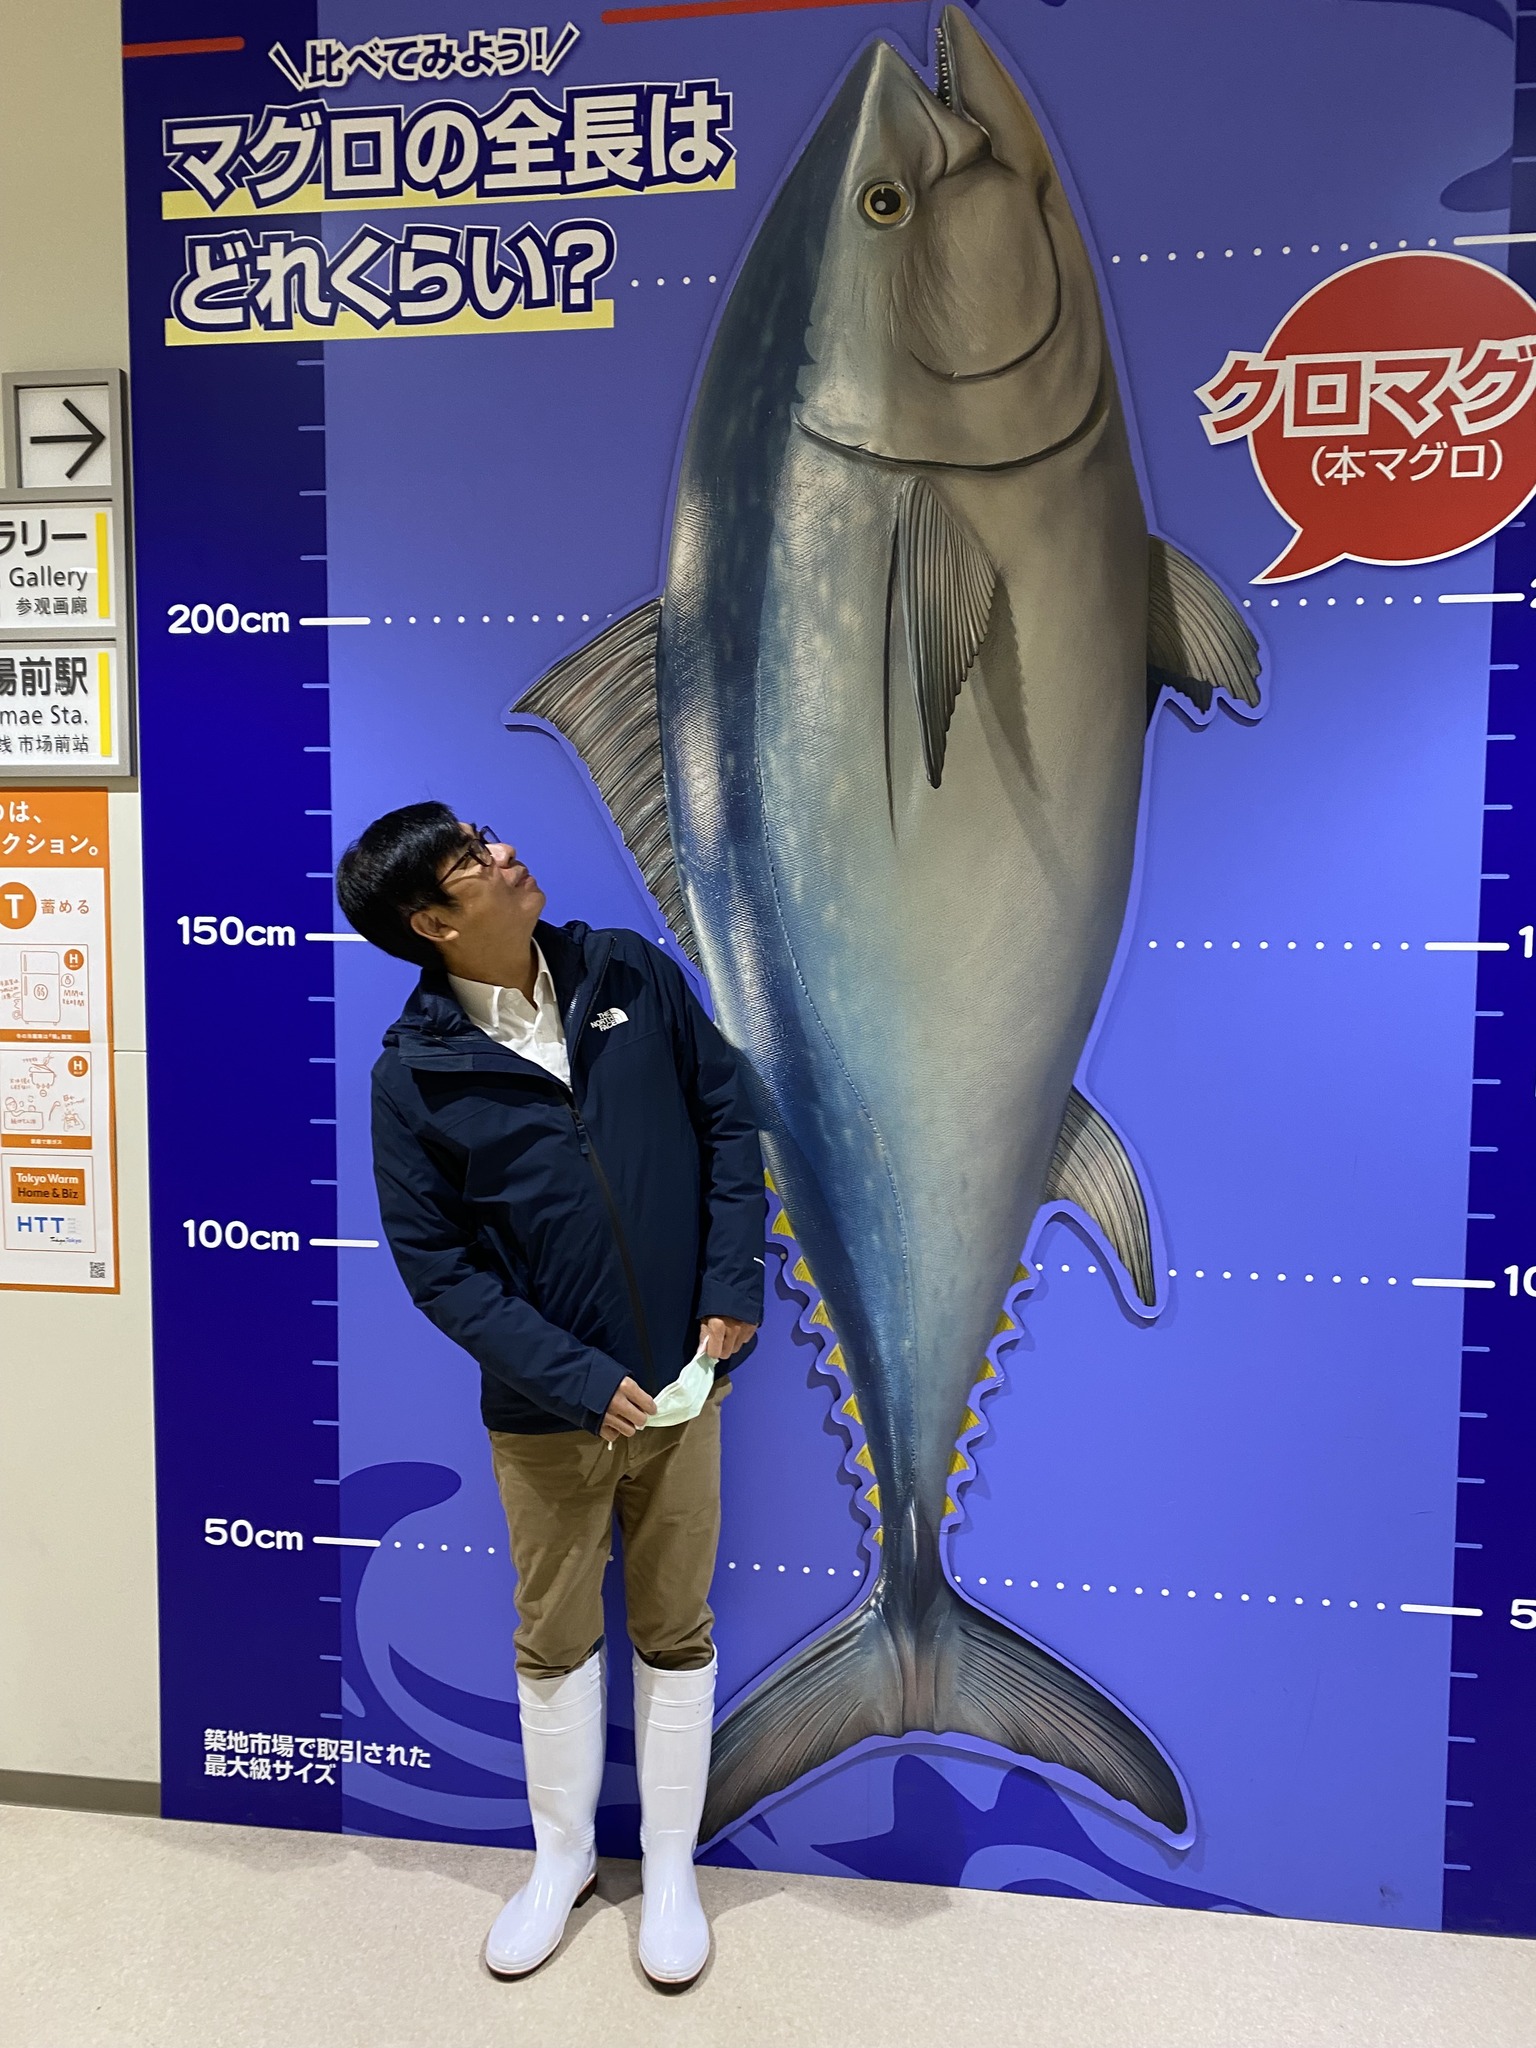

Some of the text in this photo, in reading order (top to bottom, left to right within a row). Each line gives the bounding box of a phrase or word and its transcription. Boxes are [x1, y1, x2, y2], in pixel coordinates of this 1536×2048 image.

[165, 82, 733, 207] マグロの全長は
[9, 565, 88, 591] Gallery
[16, 596, 88, 616] 参观画廊
[167, 603, 290, 634] 200cm
[50, 704, 88, 725] Sta.
[18, 734, 89, 753] 市场前站
[2, 833, 98, 856] クション。
[4, 893, 24, 919] T
[41, 899, 90, 915] 蓄める
[176, 915, 296, 946] 150cm
[16, 1172, 79, 1186] Tokyo Warm
[17, 1187, 79, 1199] Home & Biz
[17, 1215, 65, 1233] HTT
[182, 1219, 300, 1251] 100cm
[204, 1517, 304, 1551] 50cm
[204, 1728, 432, 1769] 築地市場で取引された
[204, 1754, 337, 1786] 最大級サイズ
